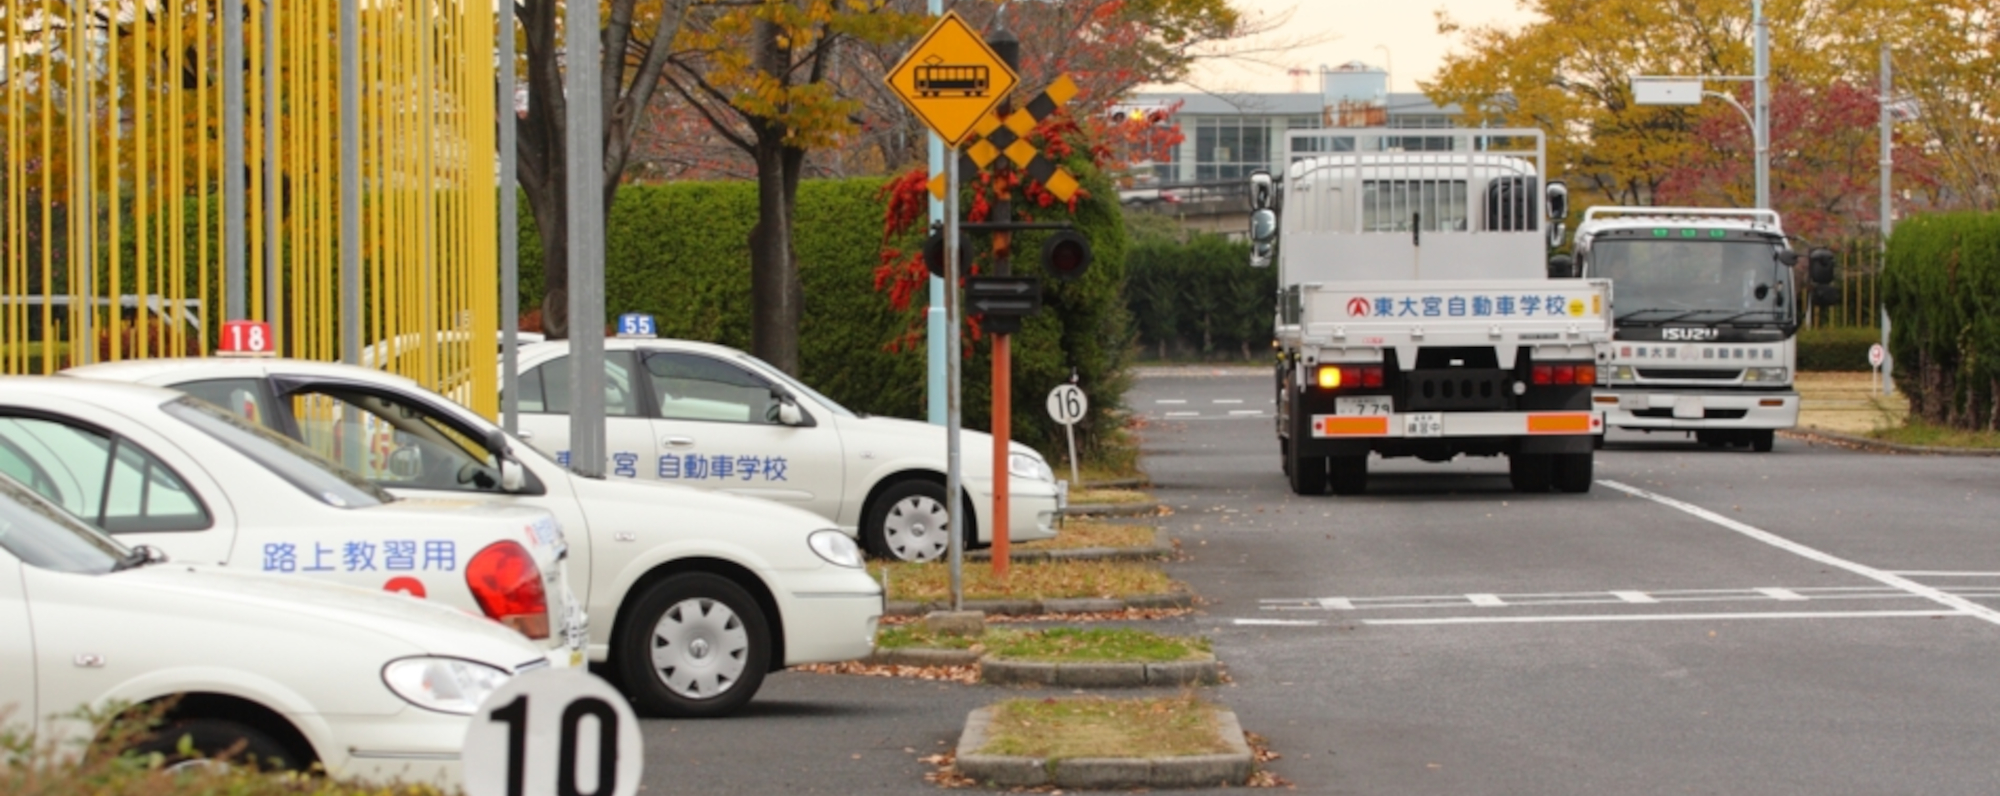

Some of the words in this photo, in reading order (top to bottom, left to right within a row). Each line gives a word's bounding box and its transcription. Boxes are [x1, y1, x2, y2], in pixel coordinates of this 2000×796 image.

[1373, 295, 1567, 317] 東大宮自動車学校
[231, 325, 265, 351] 18
[624, 316, 650, 335] 55
[1662, 328, 1719, 341] ISUZU
[1054, 387, 1081, 420] 16
[659, 453, 788, 481] 自動車学校
[262, 541, 457, 573] 路上教習用
[488, 694, 619, 796] 10
